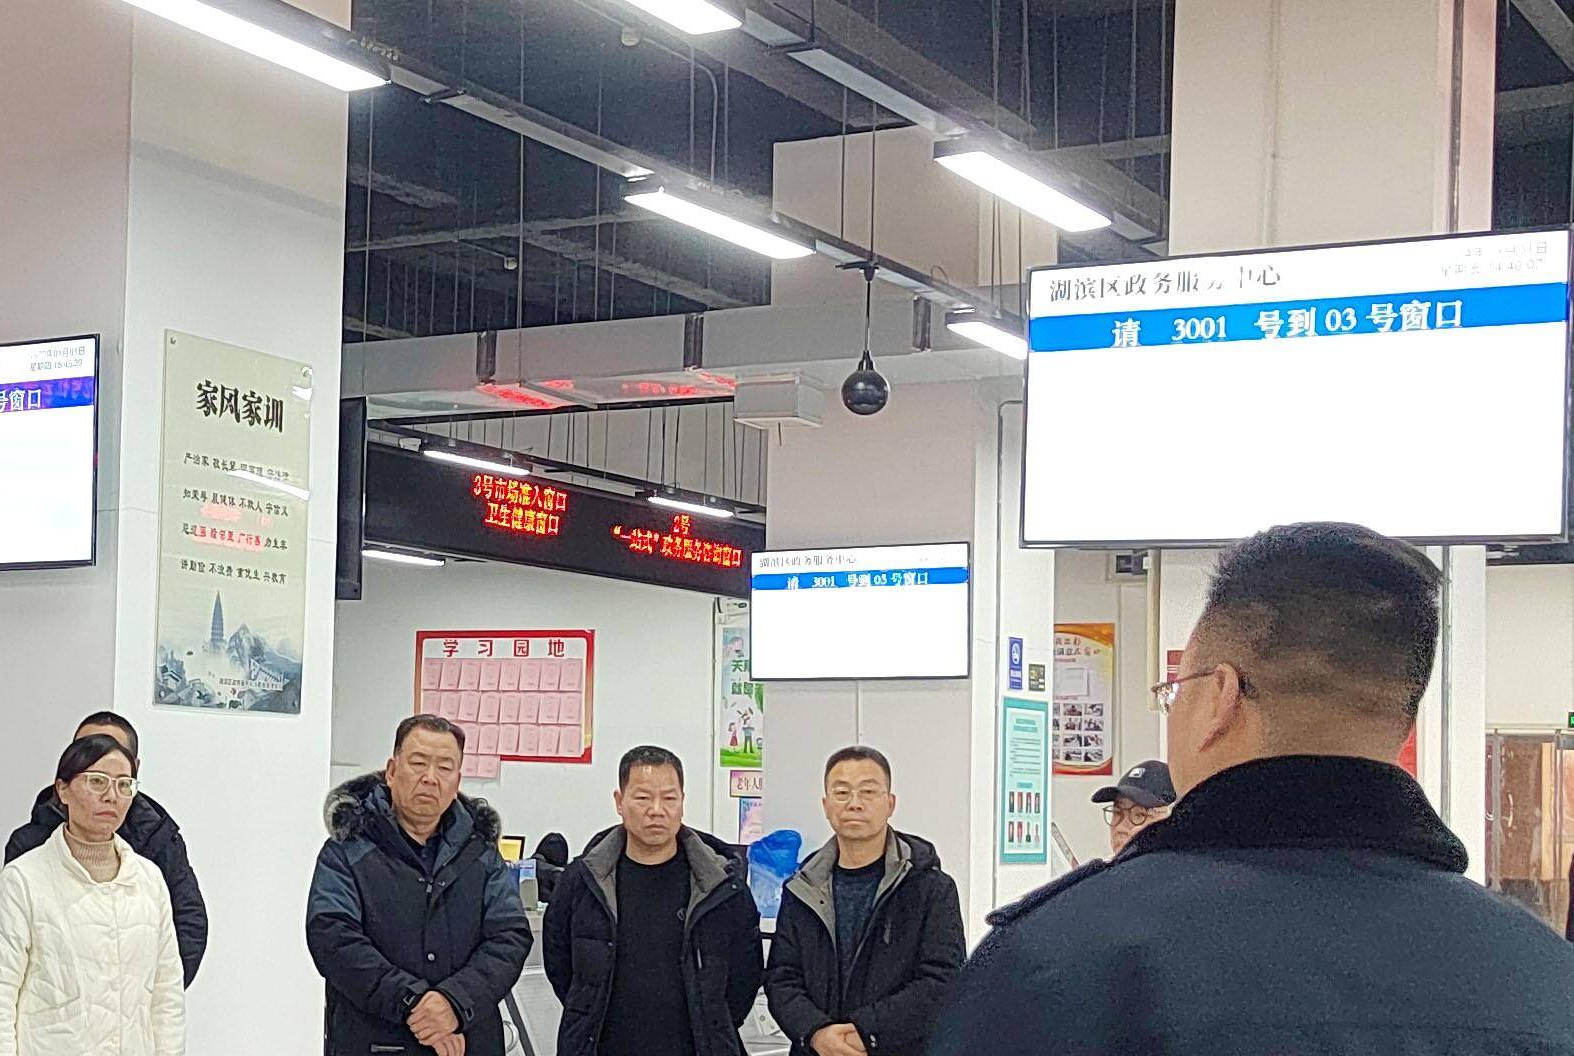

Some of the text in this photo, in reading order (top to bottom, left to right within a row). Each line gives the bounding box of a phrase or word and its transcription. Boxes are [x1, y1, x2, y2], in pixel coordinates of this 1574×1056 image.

[1112, 299, 1463, 348] 请 3001 号到 03 号窗口
[196, 379, 284, 433] 家风家训
[484, 502, 560, 536] 卫生健康窗口
[673, 514, 690, 535] 2号
[812, 576, 836, 587] 3001
[443, 638, 566, 658] 学习园地
